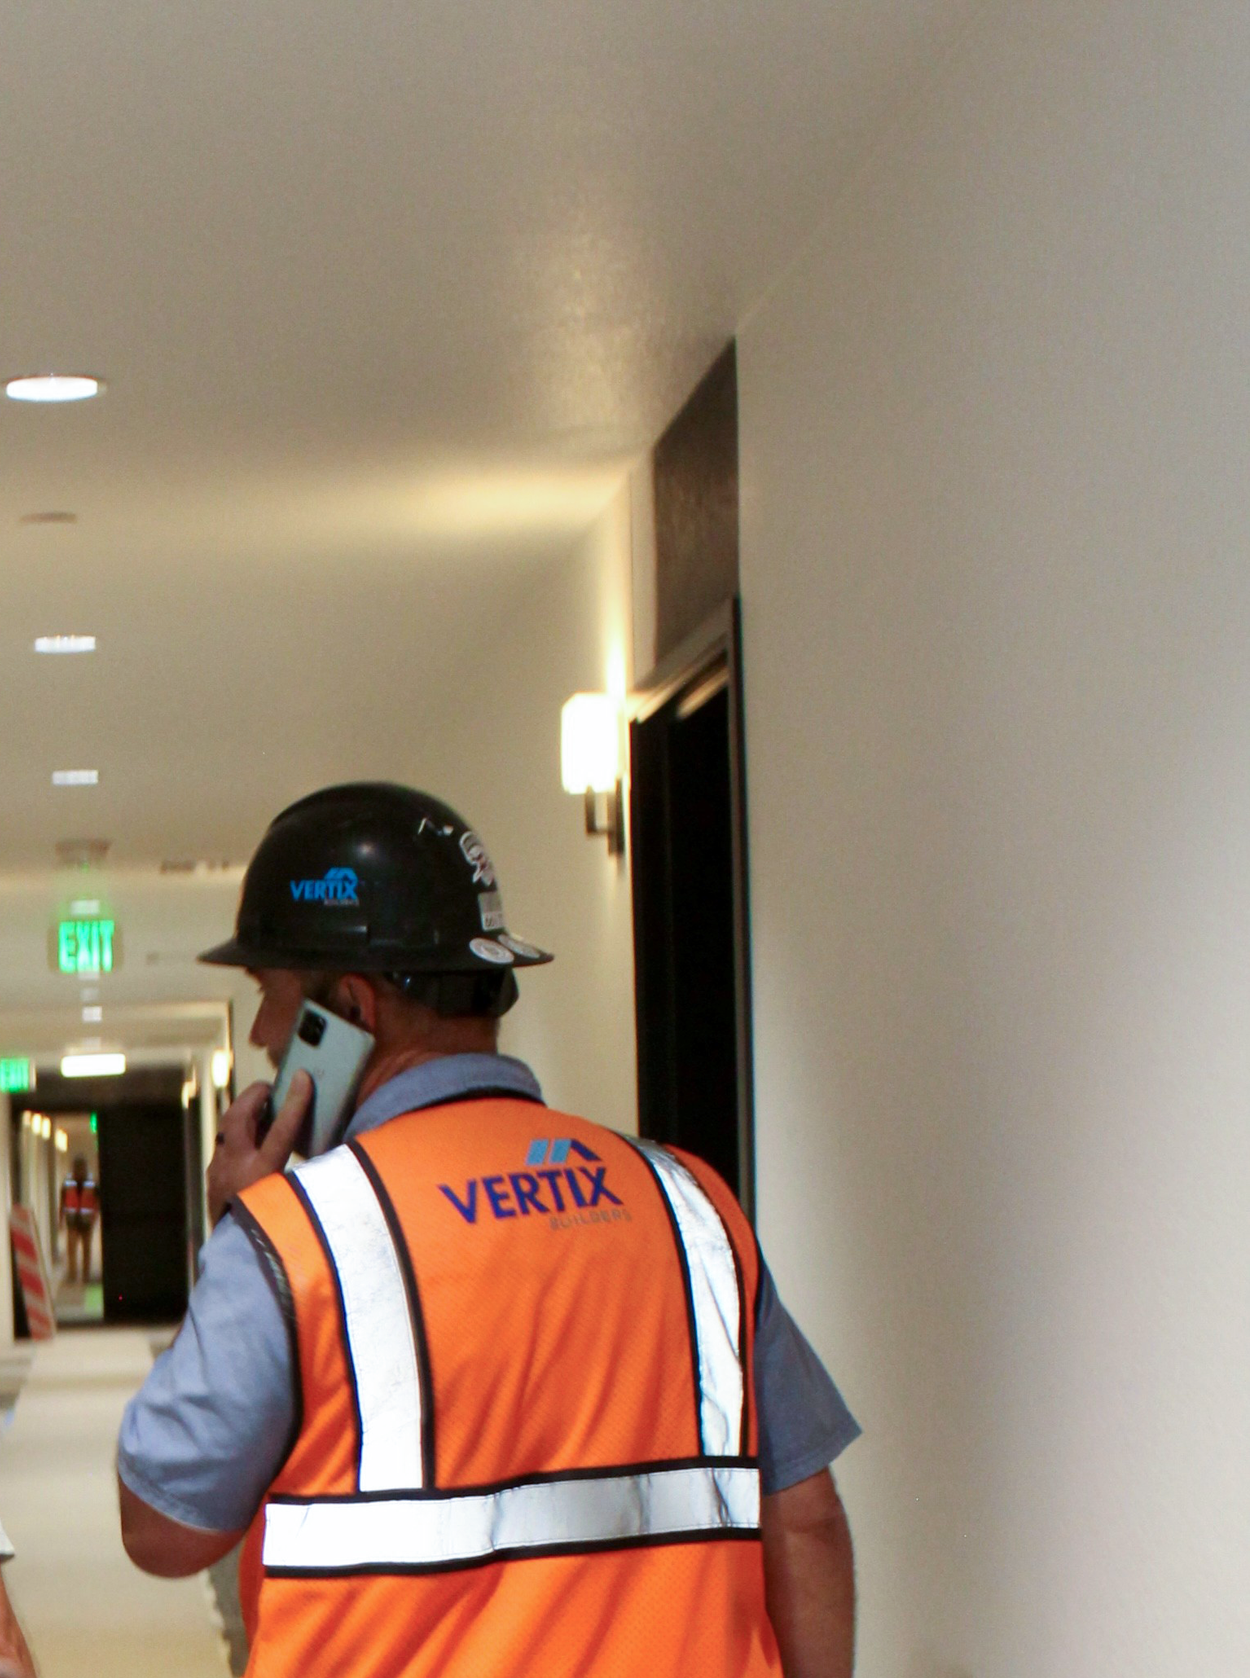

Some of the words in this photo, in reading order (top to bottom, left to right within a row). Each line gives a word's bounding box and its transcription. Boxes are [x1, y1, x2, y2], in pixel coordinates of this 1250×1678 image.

[290, 879, 358, 900] VERTIX
[58, 920, 114, 973] EXIT
[437, 1166, 623, 1224] VERTIX
